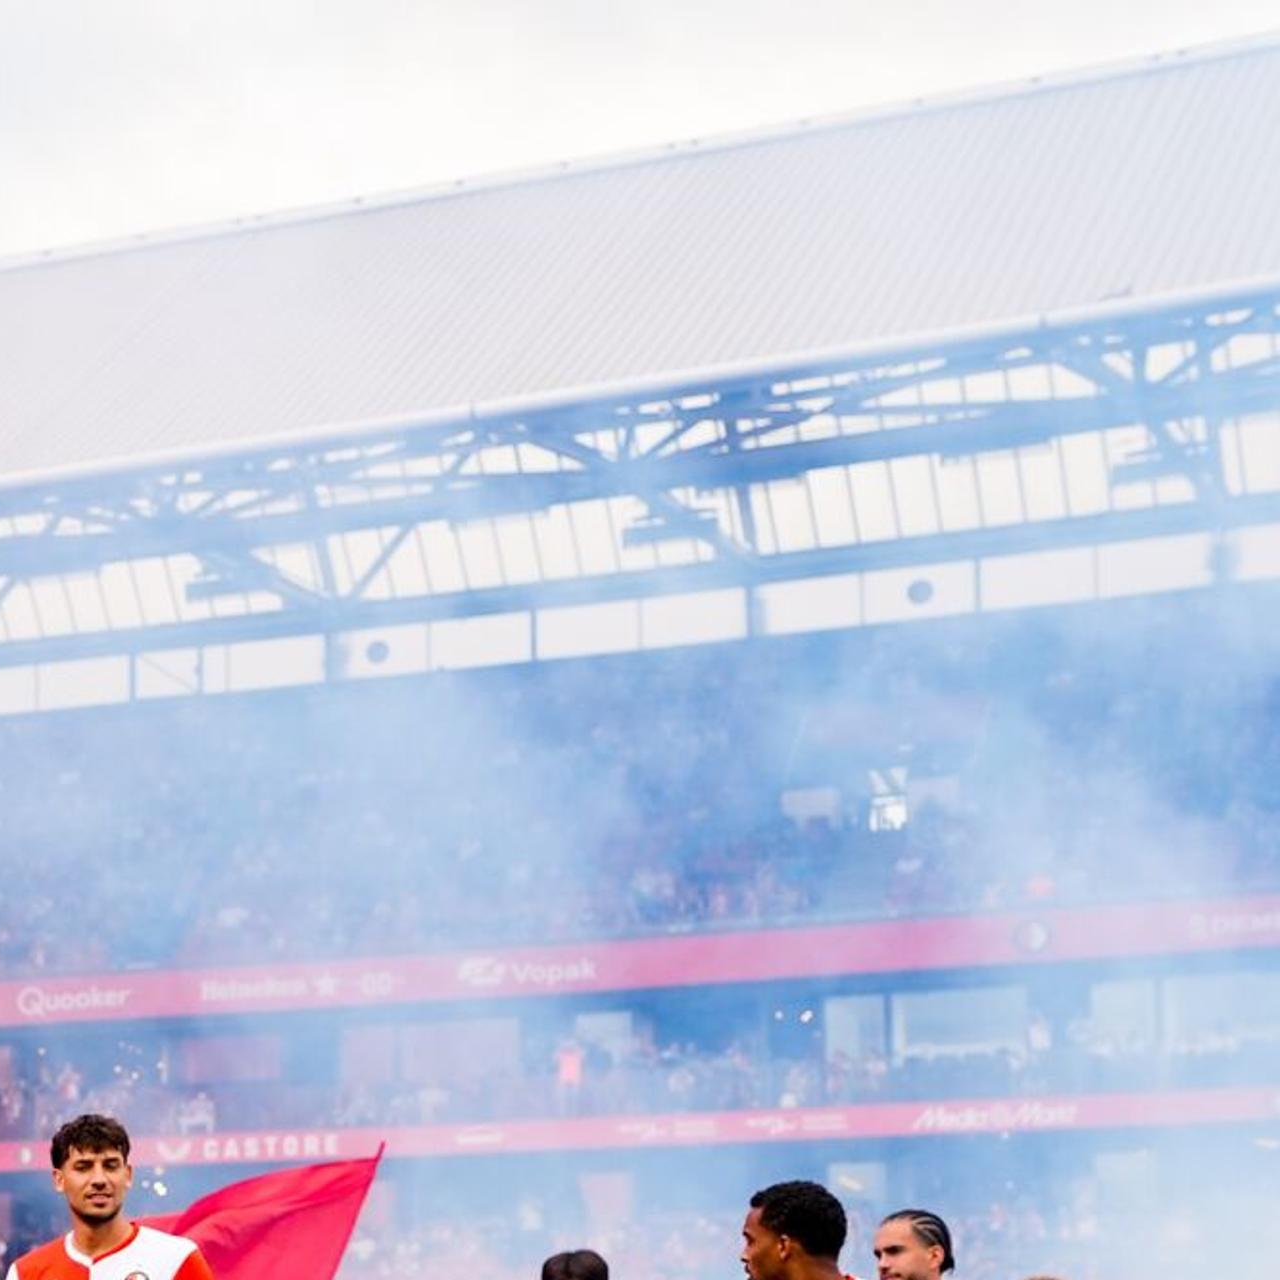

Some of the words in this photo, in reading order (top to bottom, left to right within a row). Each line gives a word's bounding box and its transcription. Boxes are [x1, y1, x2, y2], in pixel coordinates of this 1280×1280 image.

[511, 957, 597, 986] Vopak
[16, 986, 132, 1016] Quooker
[202, 1134, 339, 1160] CASTORE
